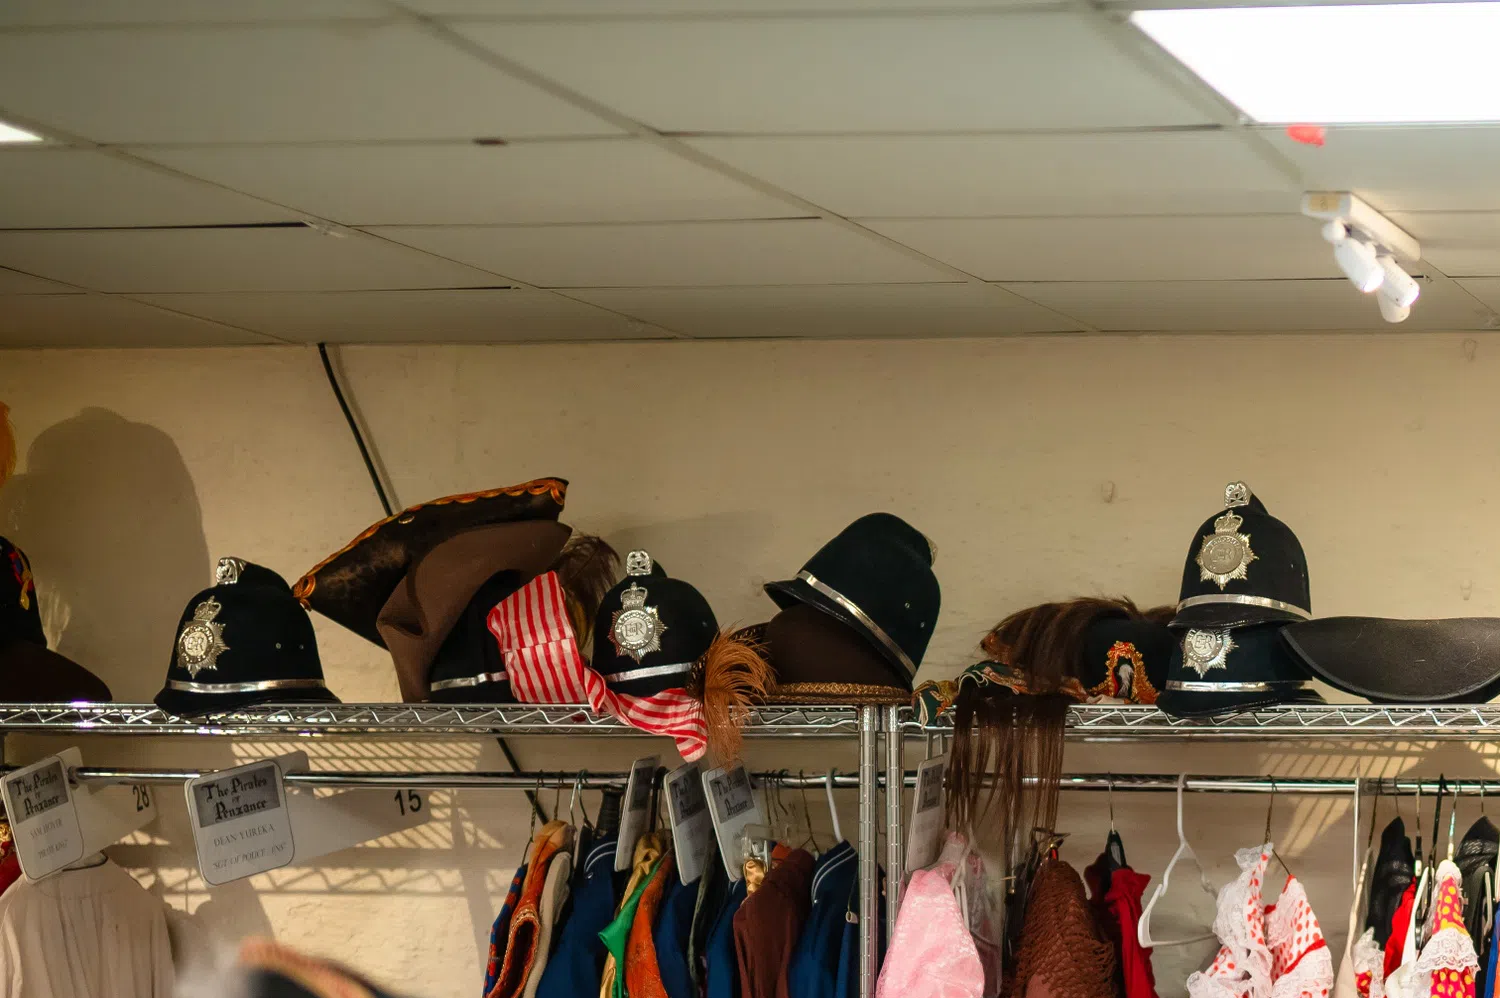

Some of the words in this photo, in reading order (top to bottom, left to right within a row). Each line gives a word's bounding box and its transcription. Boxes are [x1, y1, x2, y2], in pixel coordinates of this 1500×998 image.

[13, 779, 32, 796] The
[133, 784, 150, 812] 28
[201, 783, 228, 803] The
[230, 775, 268, 795] Pirates
[214, 800, 267, 823] Penzance
[394, 789, 422, 816] 15
